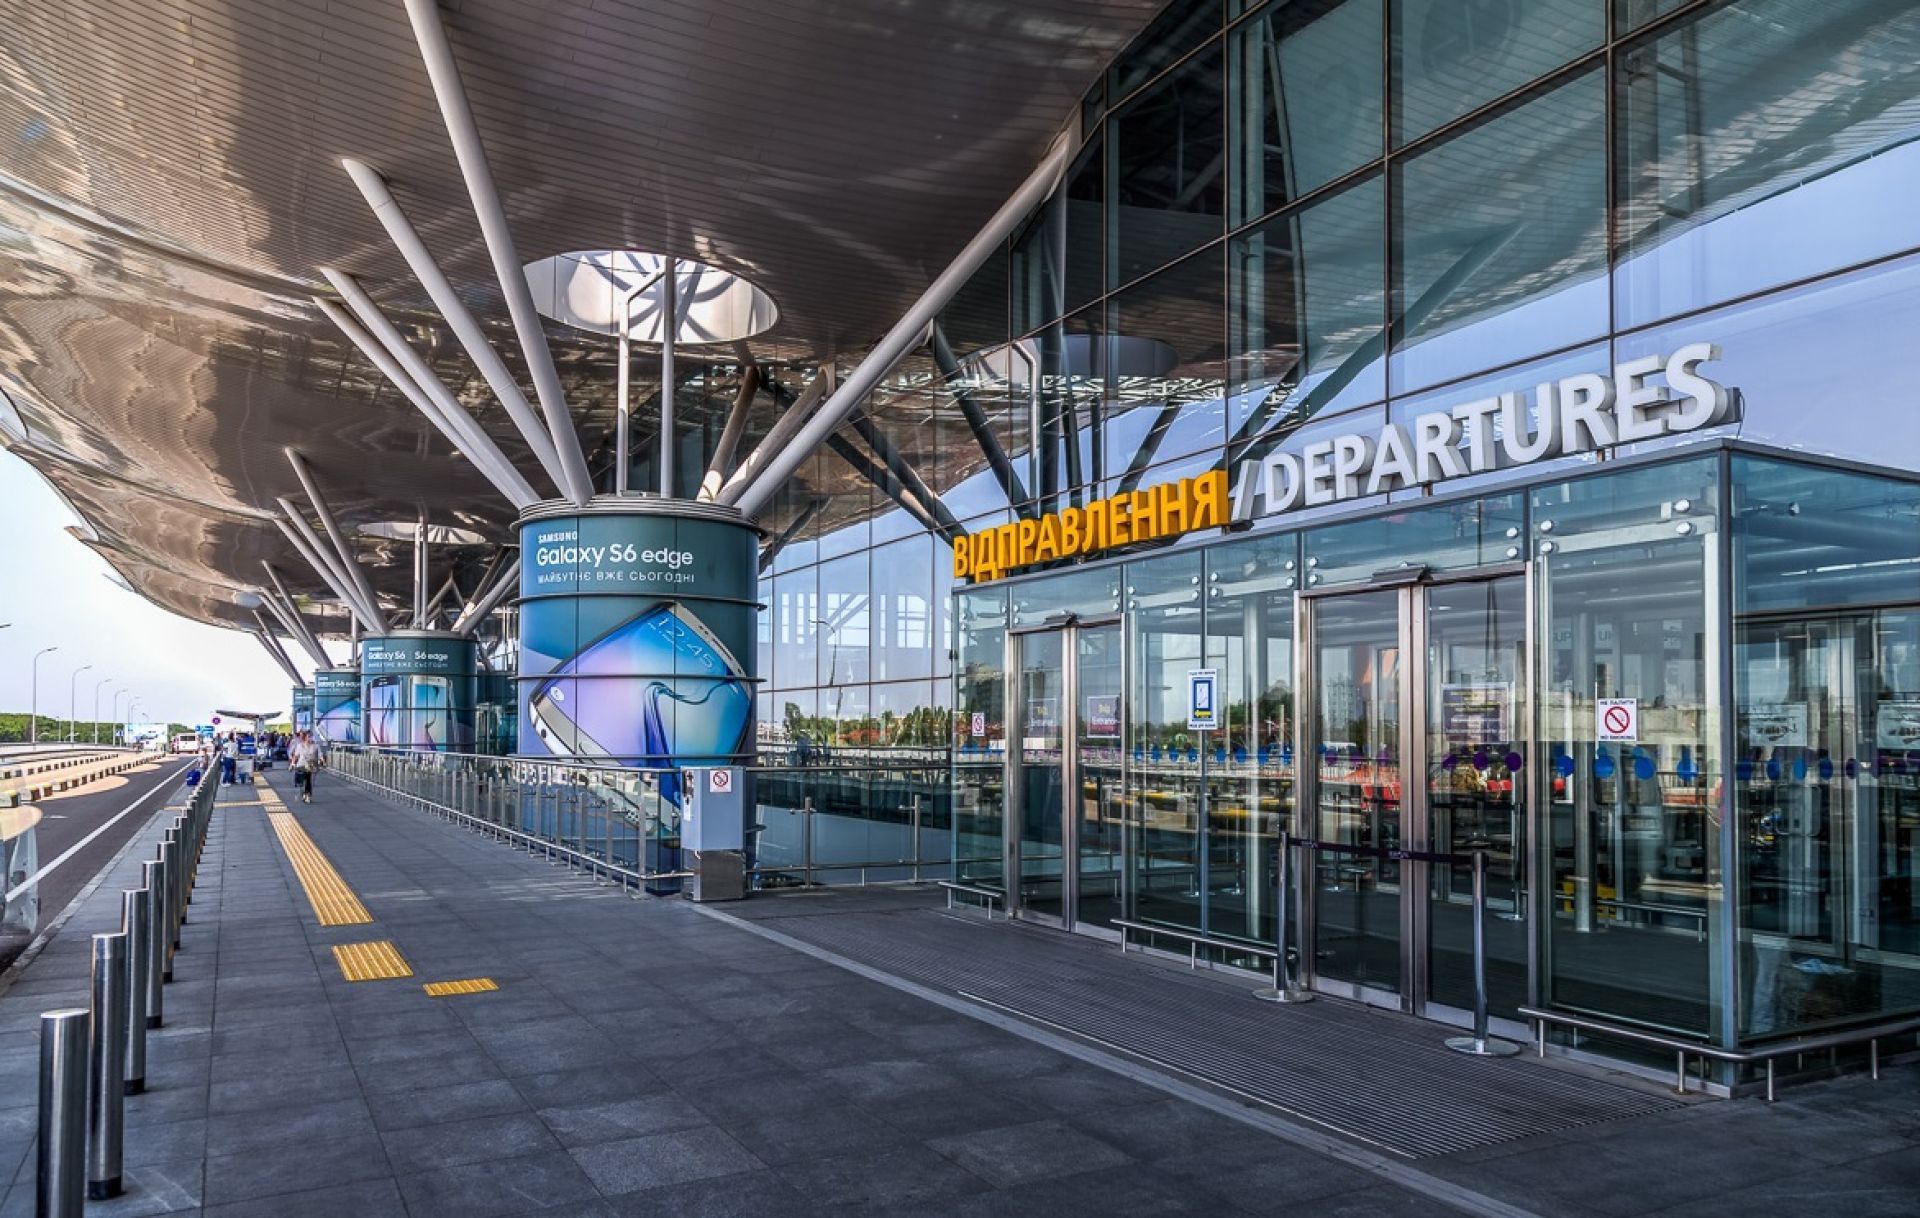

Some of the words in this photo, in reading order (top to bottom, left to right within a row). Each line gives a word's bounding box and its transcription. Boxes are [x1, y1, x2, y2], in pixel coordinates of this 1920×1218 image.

[953, 470, 1229, 583] ВІДПРАВЛЕННЯ
[537, 546, 605, 567] Galaxy
[609, 543, 637, 563] S6
[641, 548, 693, 569] edge
[596, 571, 624, 581] ВЖЕ
[629, 572, 695, 584] СЬОГОДНІ
